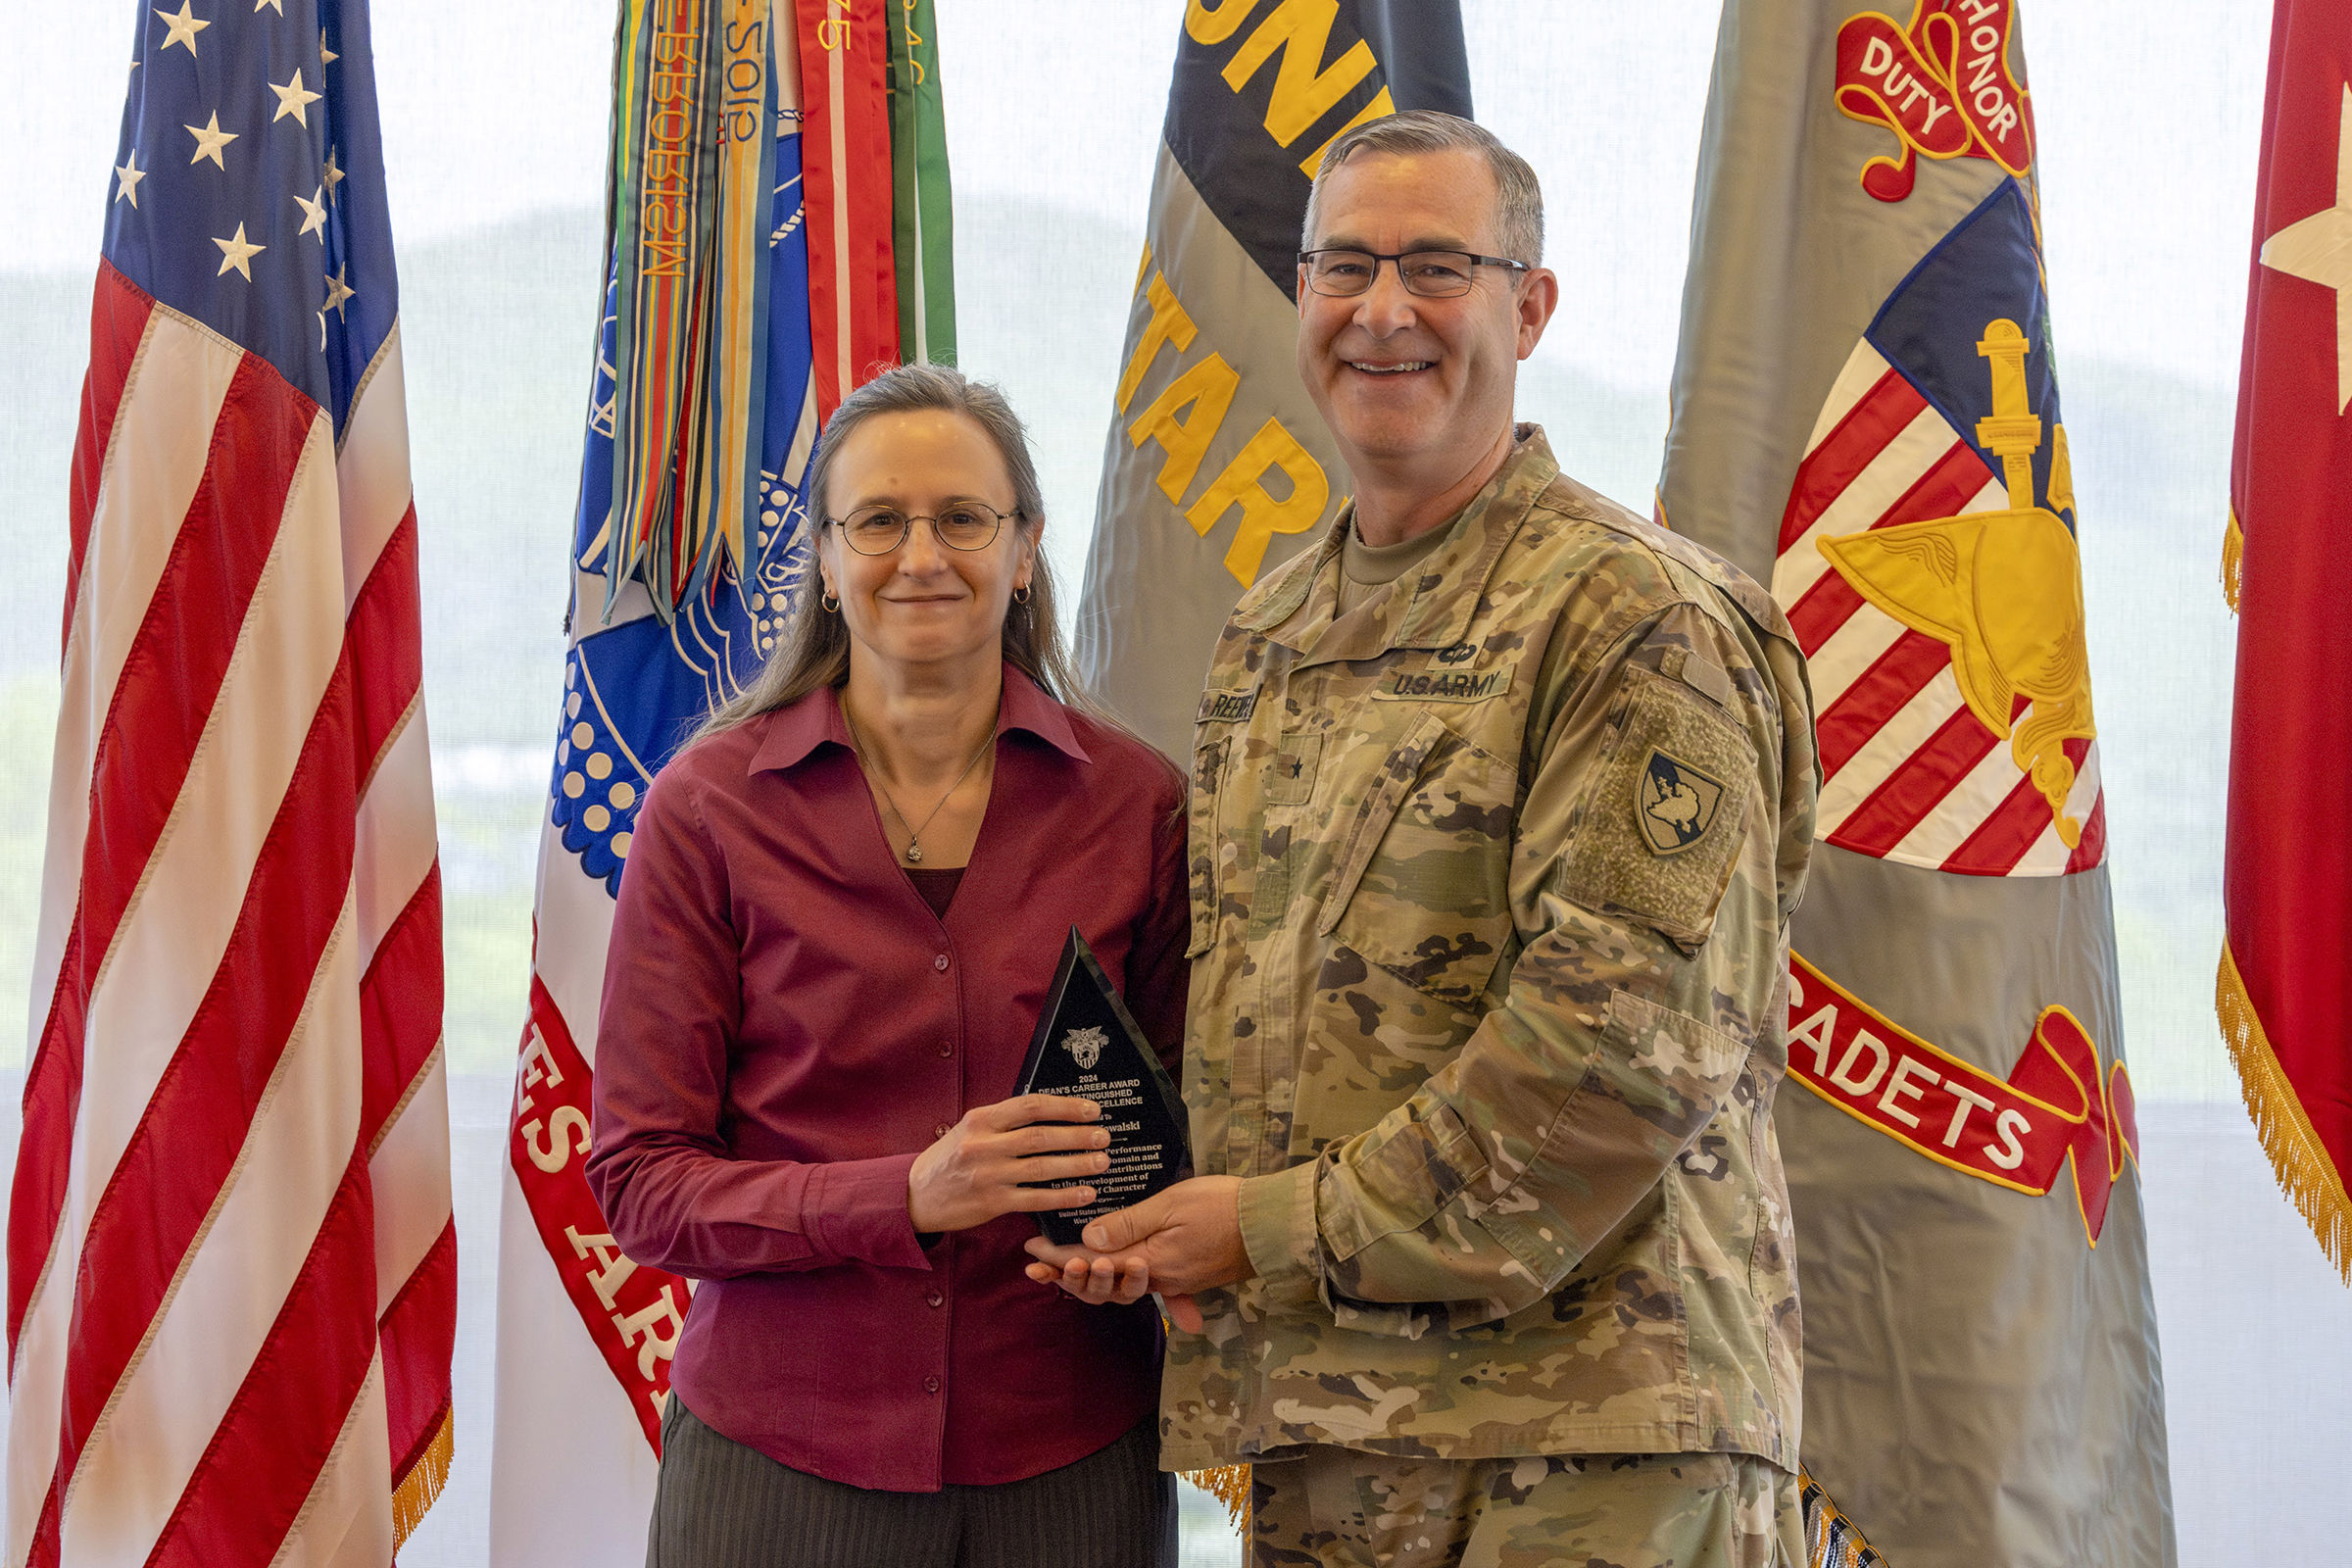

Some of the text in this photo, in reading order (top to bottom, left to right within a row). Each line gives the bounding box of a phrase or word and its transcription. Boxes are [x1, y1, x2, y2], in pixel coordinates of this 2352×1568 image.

[1958, 0, 2017, 143] HONOR
[1860, 36, 1952, 134] DUTY
[1115, 239, 1348, 591] TAR
[1039, 1078, 1141, 1095] DEAN'S CAREER AWARD
[1079, 1074, 1098, 1084] 2024
[517, 1019, 592, 1174] ES
[1100, 1120, 1141, 1133] owalski
[1104, 1143, 1162, 1155] Performance
[1142, 1152, 1159, 1161] and
[1061, 1180, 1077, 1189] the
[1078, 1174, 1138, 1187] Development
[1139, 1172, 1150, 1181] of
[1102, 1182, 1147, 1195] Character
[1058, 1208, 1079, 1218] United
[1078, 1206, 1097, 1216] States
[564, 1225, 684, 1420] AR
